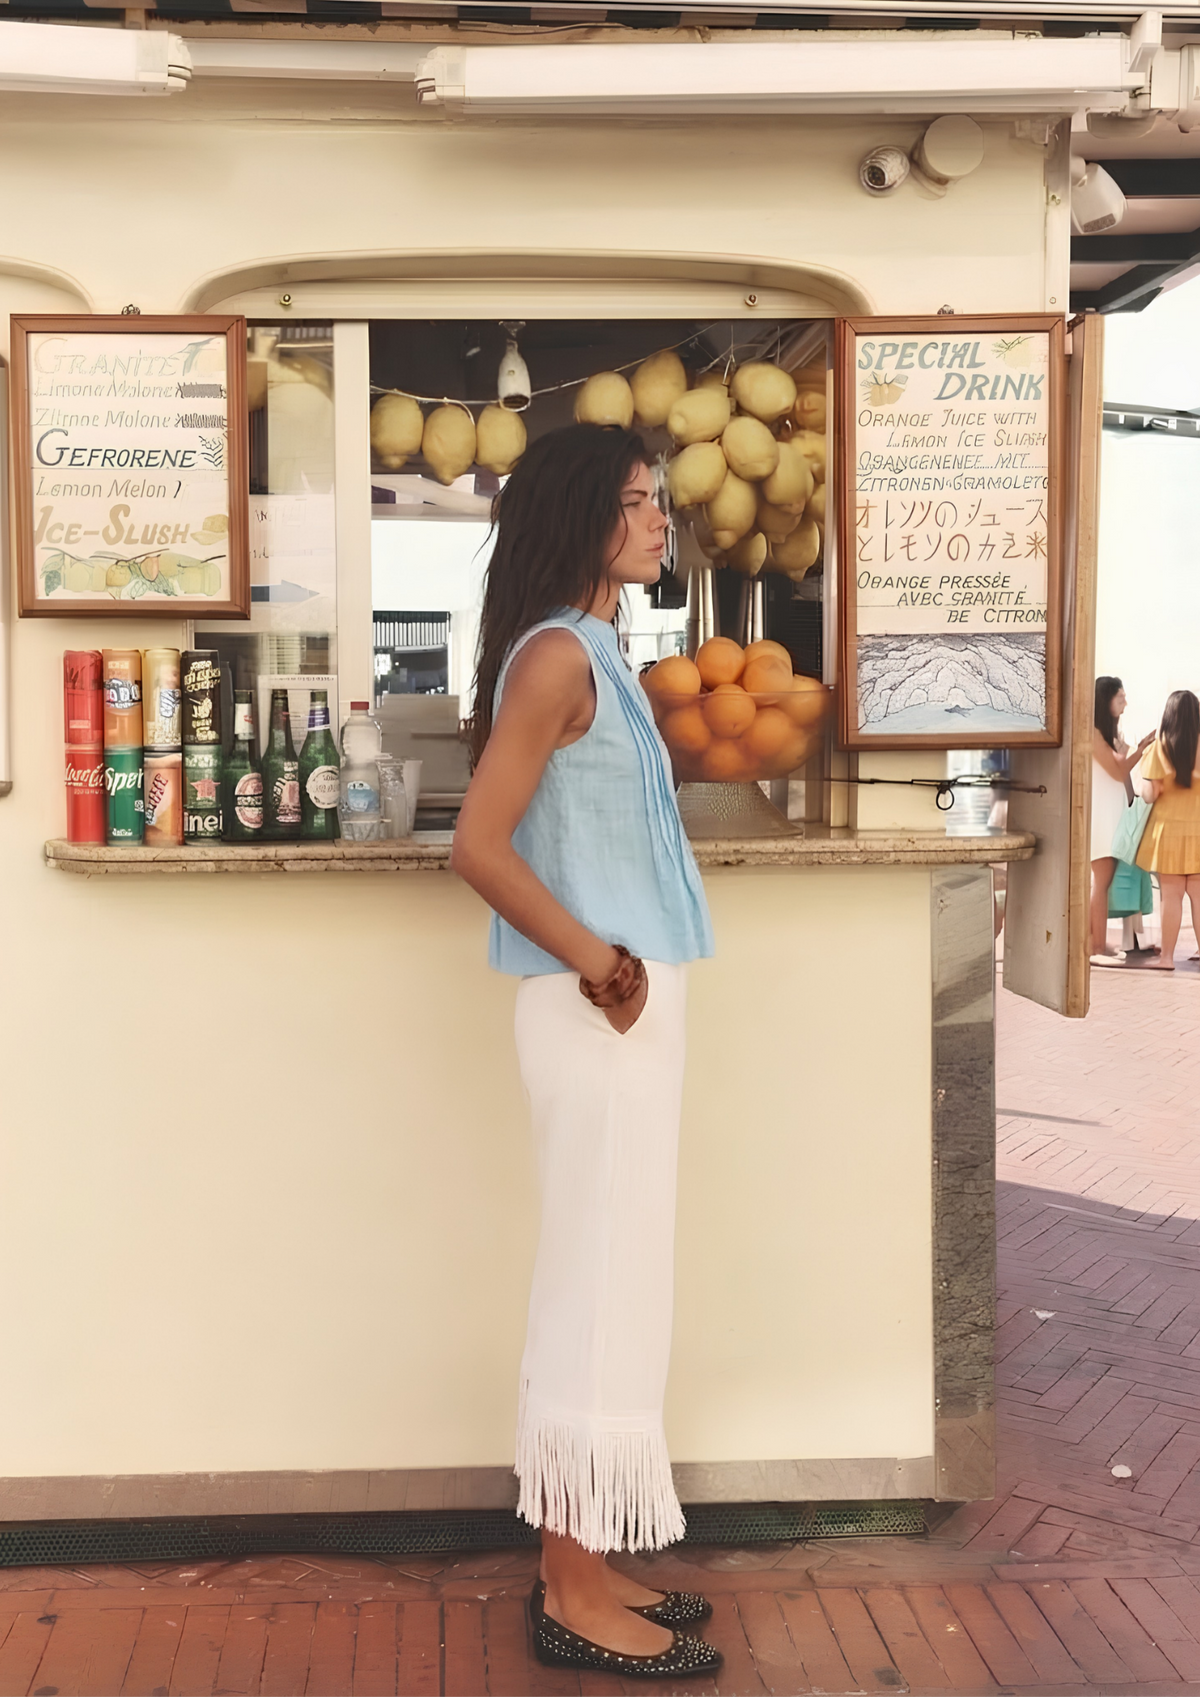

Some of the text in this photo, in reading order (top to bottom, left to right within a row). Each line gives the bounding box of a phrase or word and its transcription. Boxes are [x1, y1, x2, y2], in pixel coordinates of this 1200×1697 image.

[858, 342, 986, 370] SPECIAL
[933, 372, 1045, 400] DRINK
[107, 479, 167, 498] Melon
